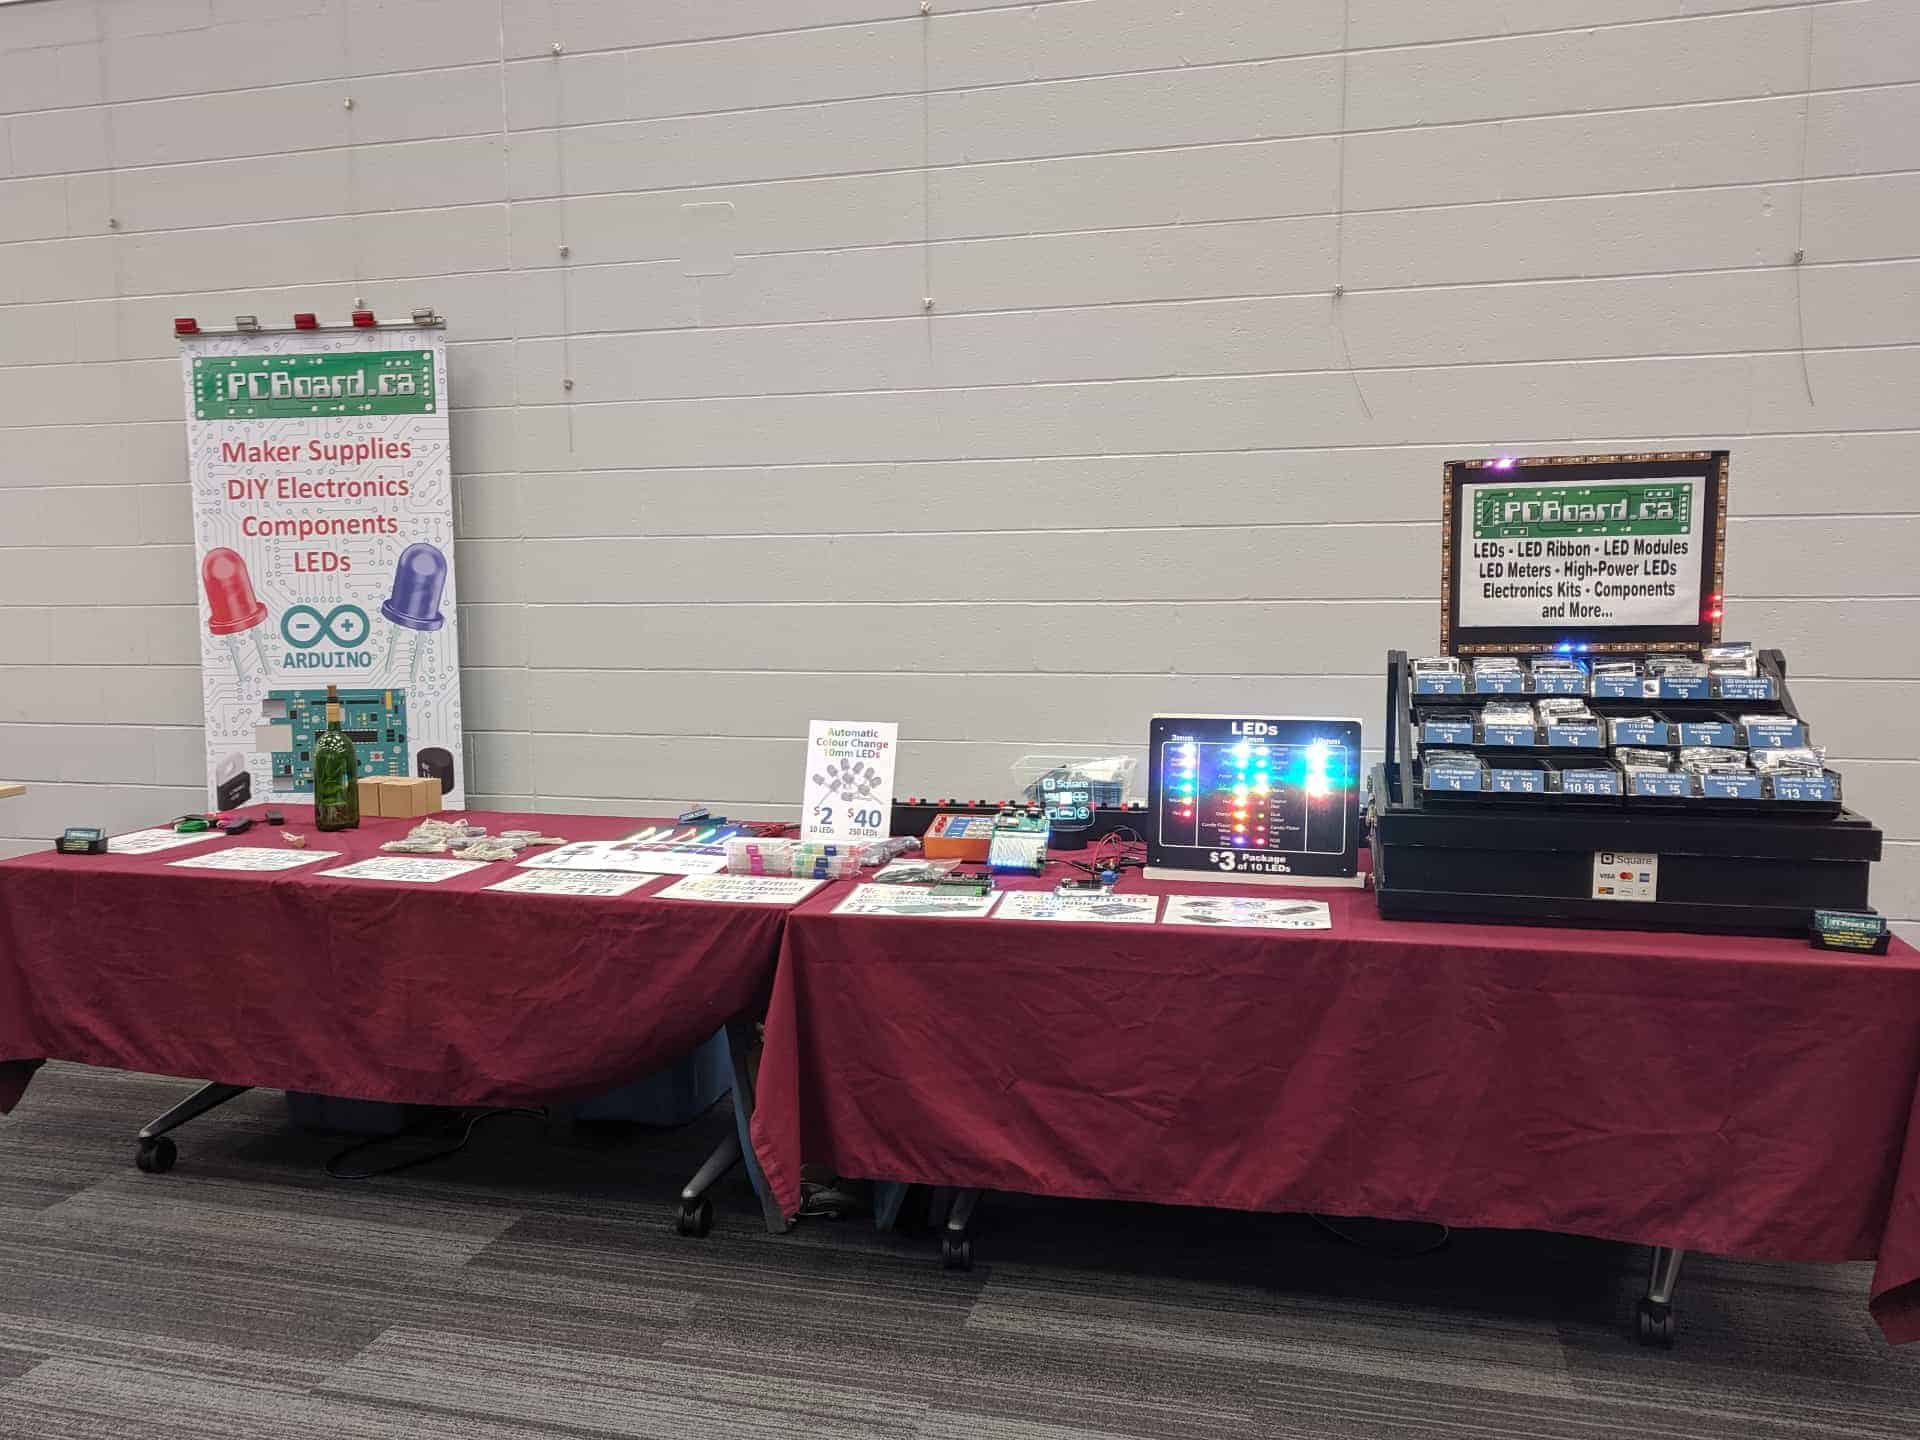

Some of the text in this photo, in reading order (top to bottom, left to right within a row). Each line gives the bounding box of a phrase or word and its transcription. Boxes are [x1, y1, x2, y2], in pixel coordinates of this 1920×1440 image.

[228, 369, 416, 400] PCBoard.ca
[222, 437, 411, 465] Maker Supplies
[228, 475, 409, 500] DIY Electronics
[1504, 499, 1673, 523] PCBoard.ca
[242, 515, 398, 540] Components
[1474, 542, 1505, 558] LEDs
[1517, 541, 1542, 558] LED
[1547, 540, 1591, 557] Ribbon
[1604, 540, 1629, 556] LED
[1634, 539, 1688, 555] Modules
[294, 552, 351, 573] LEDs
[1480, 563, 1503, 579] LED
[1508, 562, 1551, 578] Meters
[1564, 561, 1639, 581] High-Power
[1644, 559, 1677, 576] LEDs
[1484, 582, 1553, 598] Electronics
[1557, 582, 1581, 597] Kits
[1594, 581, 1675, 600] Components
[1542, 602, 1613, 618] and More...
[282, 651, 372, 669] ARDUINO
[1615, 687, 1624, 696] $5
[1679, 688, 1688, 698] $5
[827, 728, 879, 738] Automatic
[1231, 721, 1279, 736] LEDs
[816, 737, 888, 750] Colour Change
[1569, 736, 1578, 746] $4
[825, 748, 880, 759] 10mm LEDs
[1056, 779, 1089, 790] Square
[1501, 781, 1532, 792] $4 $8
[1564, 783, 1581, 793] $10
[1600, 784, 1610, 793] $5
[1645, 784, 1680, 794] $4 $5
[1727, 786, 1738, 797] $3
[1782, 788, 1822, 799] $13 $4
[814, 806, 882, 828] $2 $40
[810, 825, 834, 834] 10 LEDs
[849, 828, 878, 837] 250 LEDs
[1209, 851, 1287, 871] $3 Package
[1616, 855, 1653, 866] Square
[1265, 864, 1291, 872] LEDs
